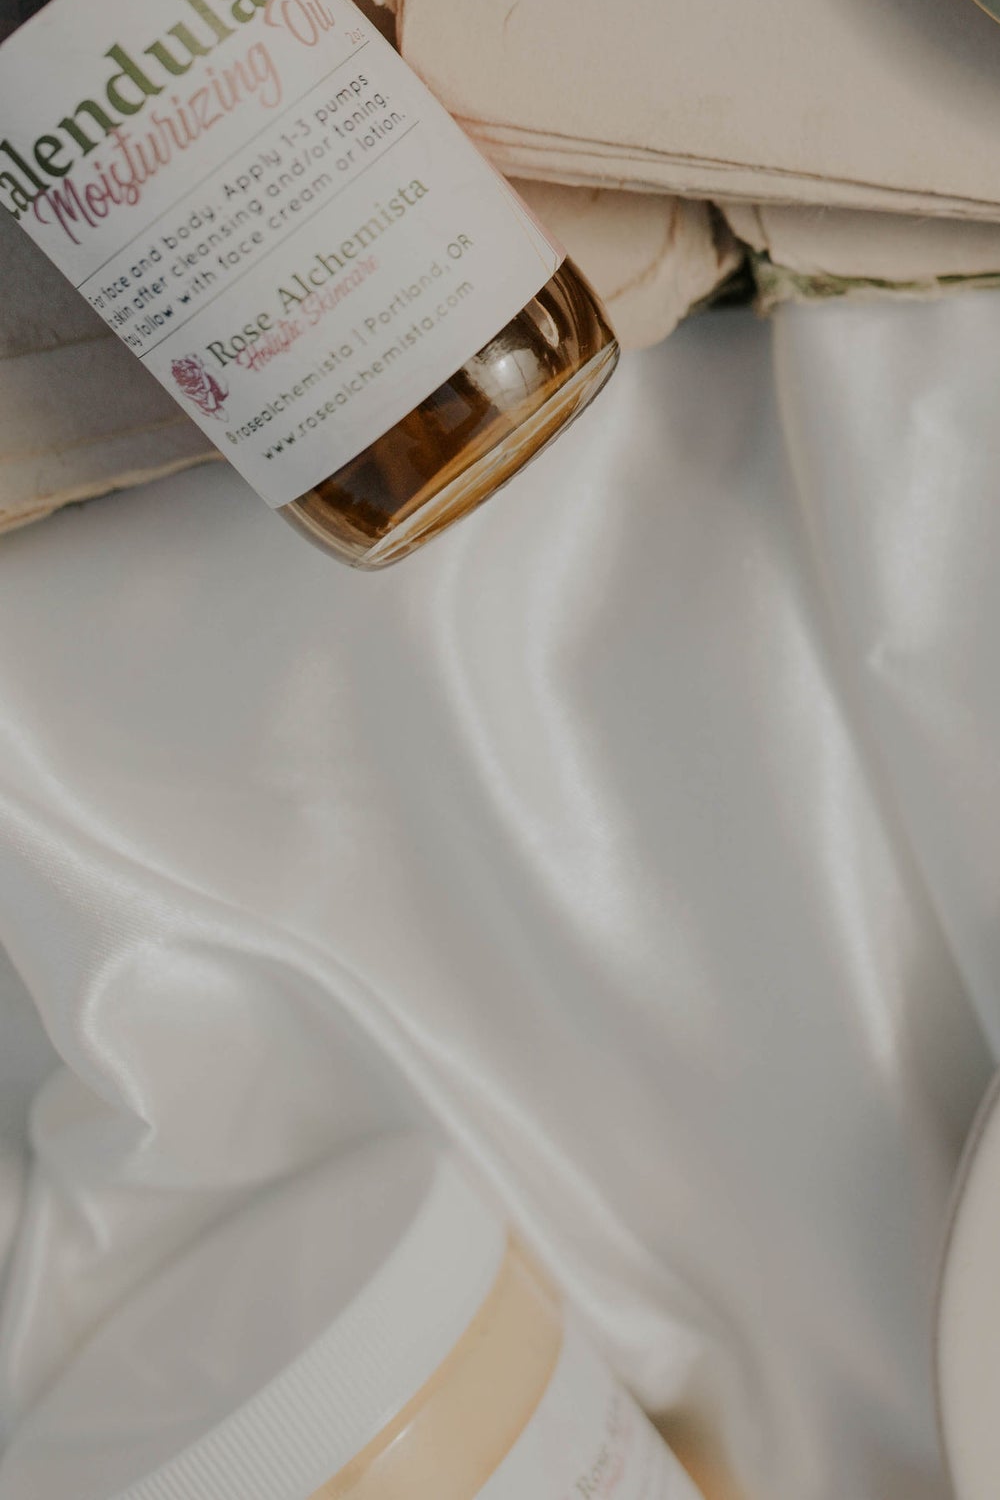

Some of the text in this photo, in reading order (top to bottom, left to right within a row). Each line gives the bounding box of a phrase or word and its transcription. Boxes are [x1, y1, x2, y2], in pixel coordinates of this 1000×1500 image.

[33, 42, 282, 245] Moisturizing
[130, 247, 162, 278] and
[162, 204, 222, 250] body.
[223, 148, 283, 200] Apply
[281, 119, 312, 147] 1-3
[315, 74, 369, 126] pumps
[134, 275, 168, 310] after
[171, 199, 264, 278] cleansing
[266, 137, 331, 199] and/or
[334, 91, 391, 138] toning.
[137, 307, 175, 339] follow
[181, 270, 217, 305] with
[218, 231, 264, 270] face
[269, 170, 333, 230] cream
[336, 149, 355, 172] or
[356, 112, 407, 151] lotion.
[206, 178, 430, 367] Rose Alchemista
[262, 281, 474, 461] www.rosealchemista.com
[363, 261, 451, 335] Portland,
[446, 233, 474, 260] OR
